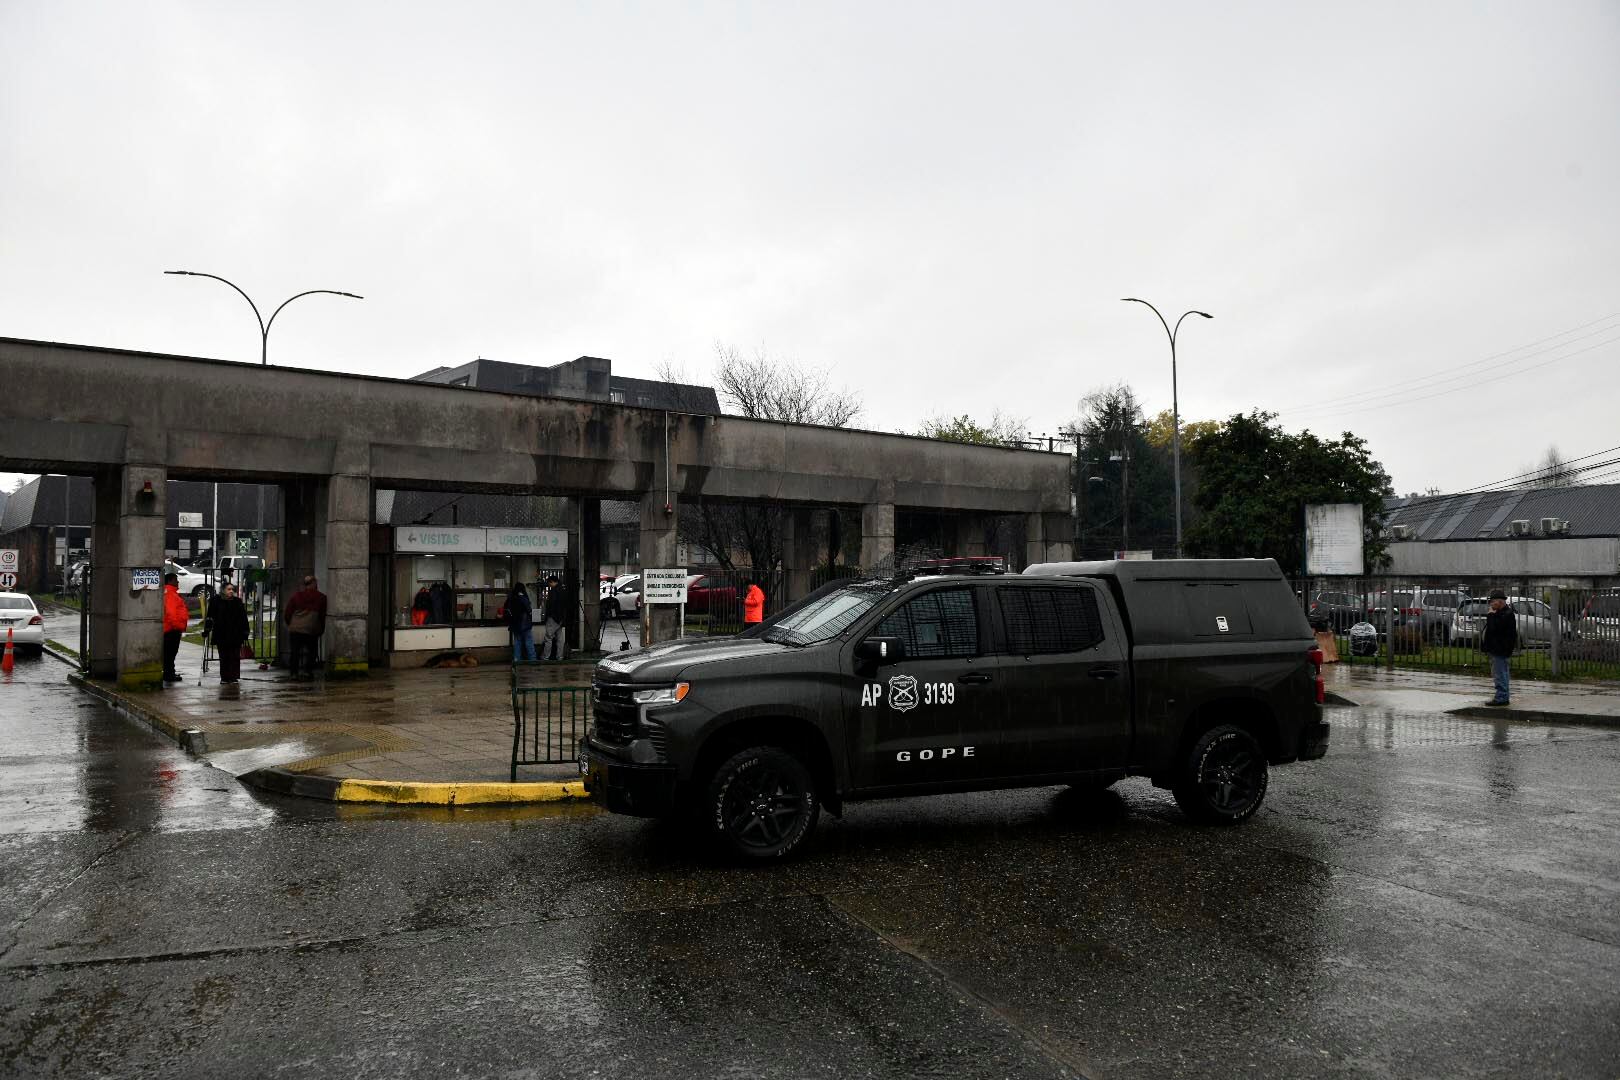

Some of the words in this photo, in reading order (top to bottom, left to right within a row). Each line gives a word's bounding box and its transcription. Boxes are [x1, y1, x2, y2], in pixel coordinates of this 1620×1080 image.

[419, 533, 460, 546] VISITAS
[500, 534, 548, 546] URGENCIA
[133, 577, 159, 585] VISITAS
[861, 683, 882, 707] AP
[924, 682, 955, 705] 3139
[896, 746, 976, 762] GOPE
